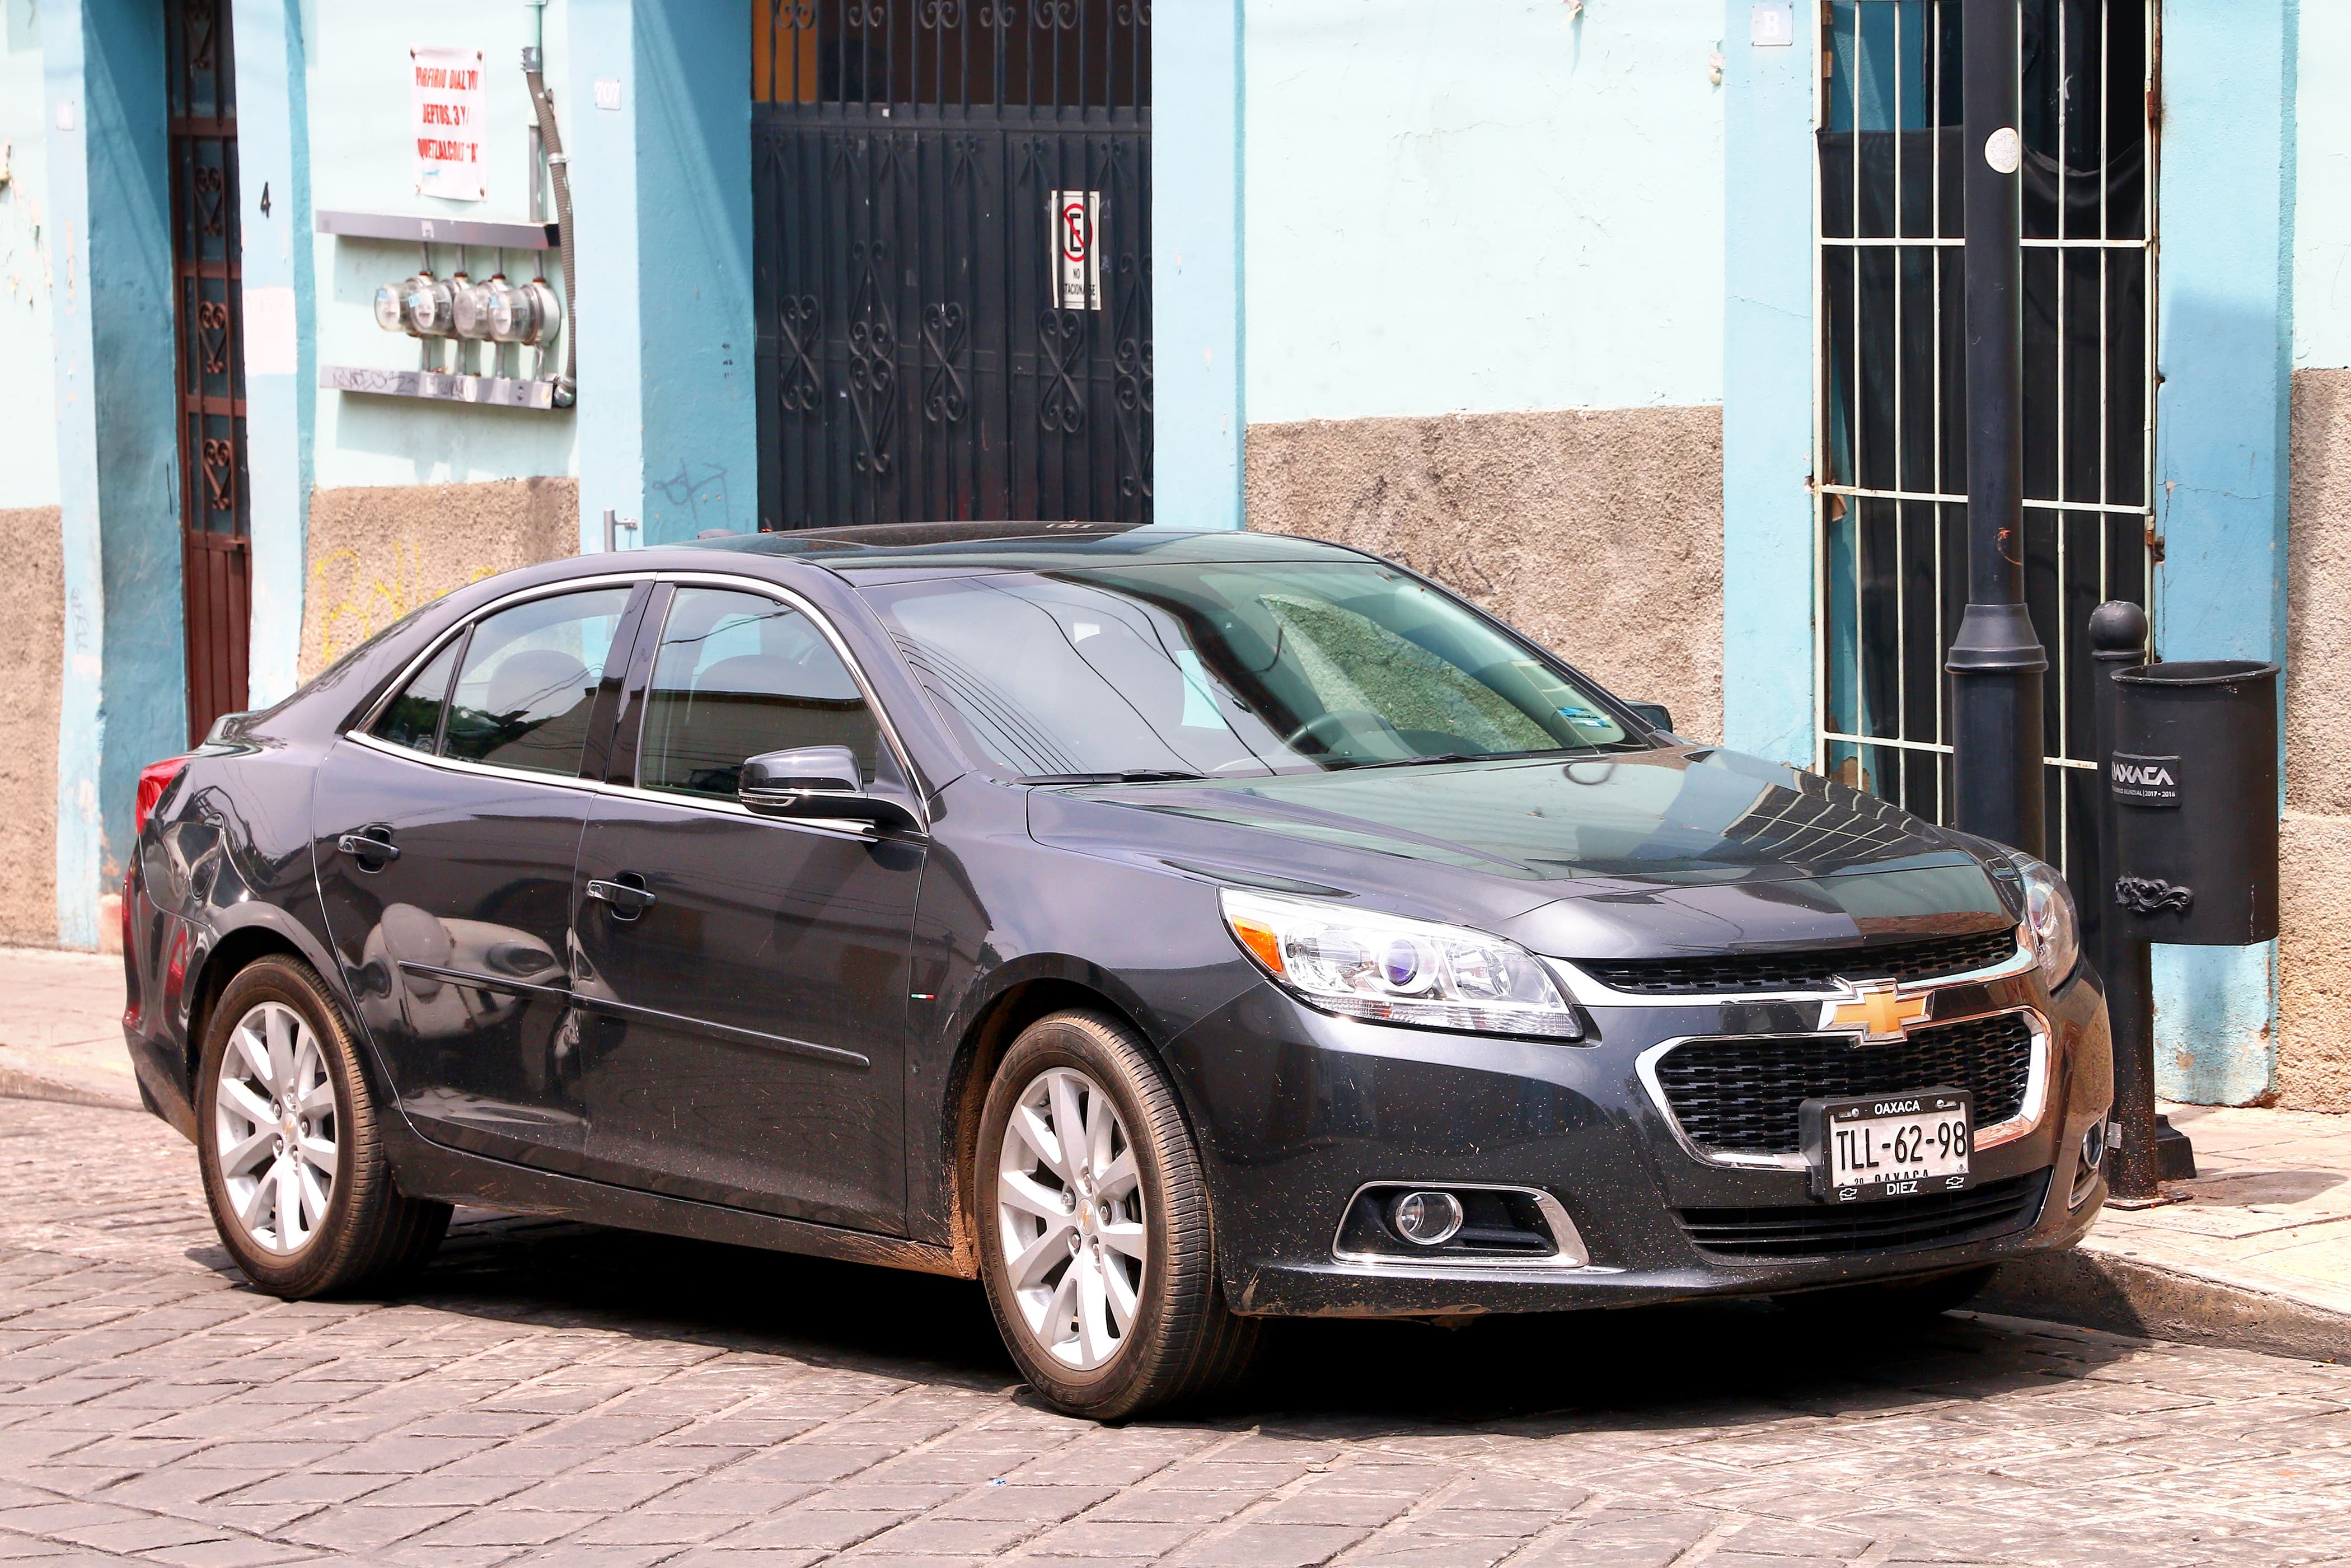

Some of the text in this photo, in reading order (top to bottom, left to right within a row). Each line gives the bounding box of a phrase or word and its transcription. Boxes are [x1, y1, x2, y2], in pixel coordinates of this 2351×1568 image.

[453, 106, 460, 126] 3
[260, 181, 271, 219] 4
[1070, 213, 1081, 251] E
[1073, 268, 1080, 279] NO
[1874, 1100, 1921, 1115] OAXACA
[1836, 1121, 1966, 1171] TLL-62-98
[1886, 1181, 1918, 1196] DIEZ
